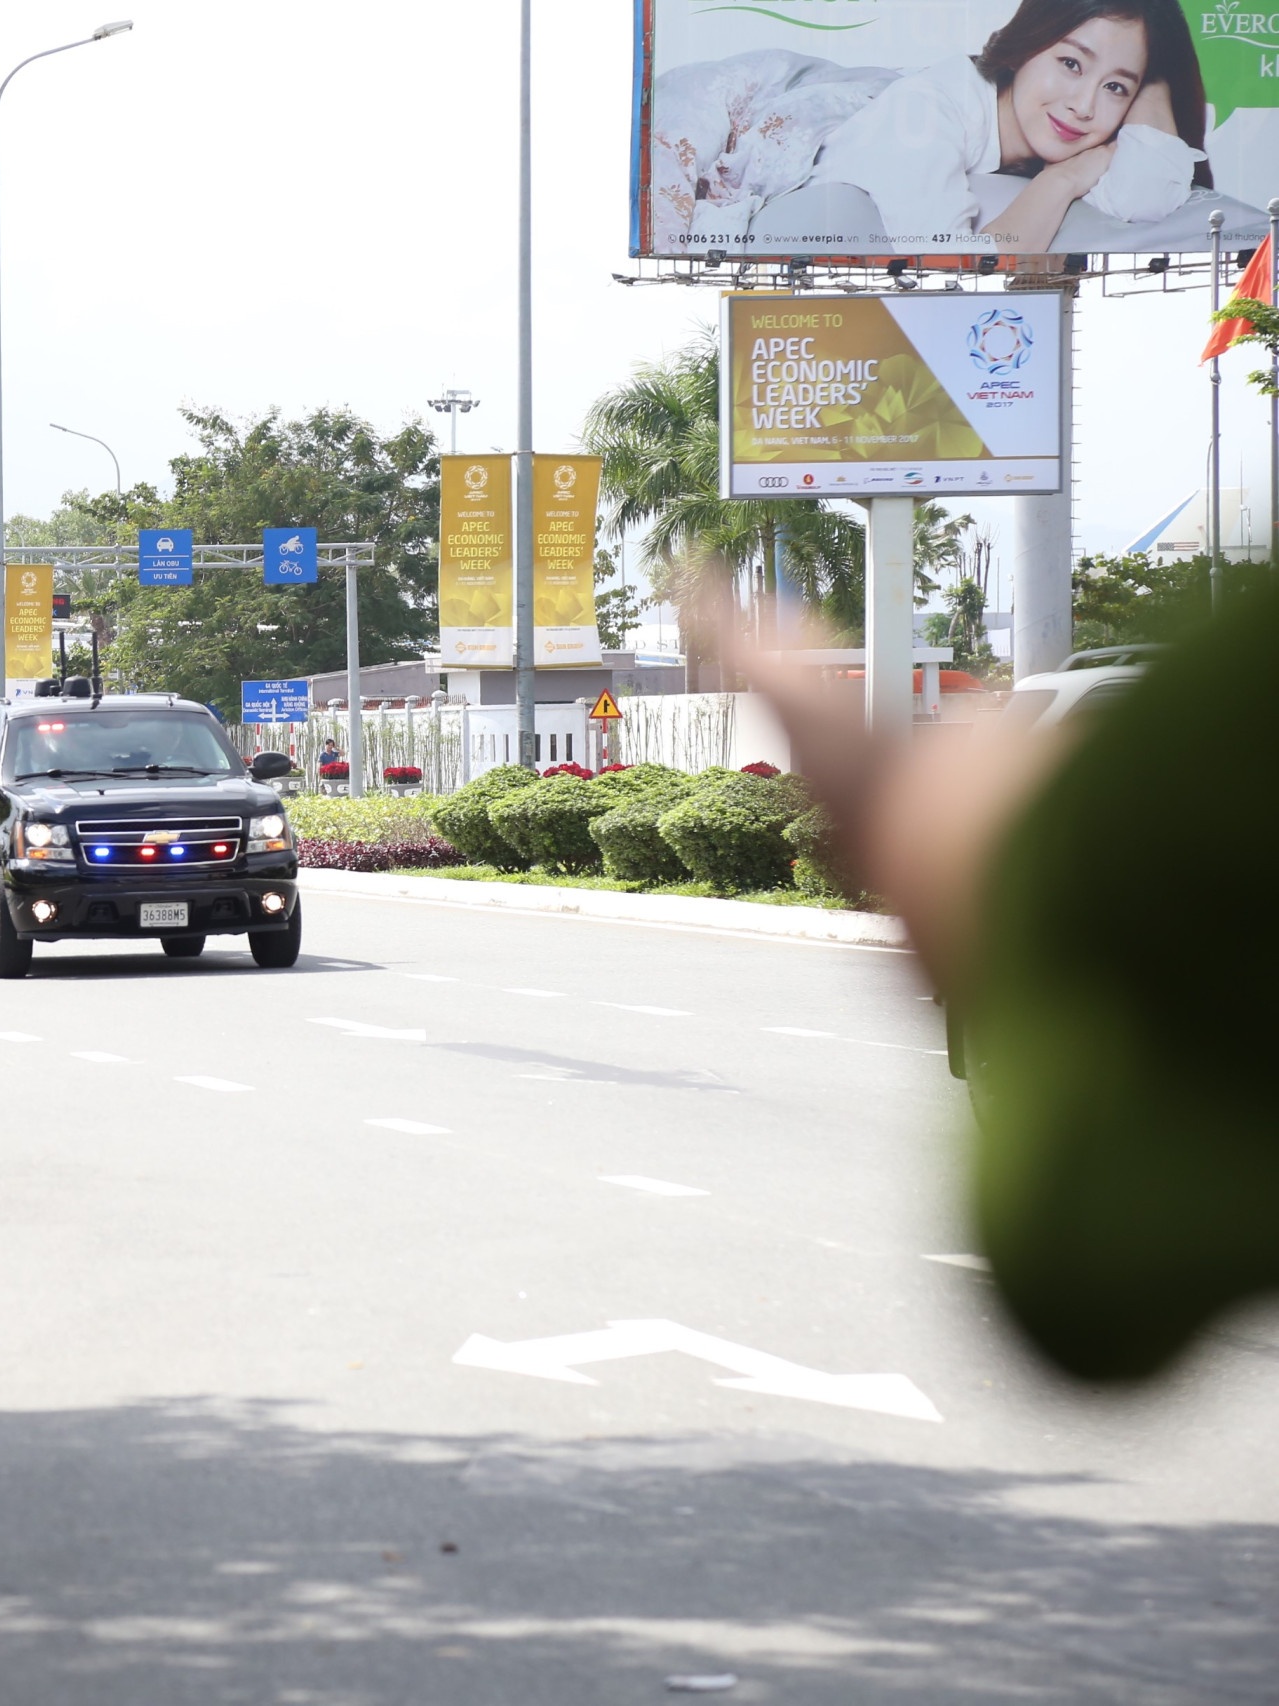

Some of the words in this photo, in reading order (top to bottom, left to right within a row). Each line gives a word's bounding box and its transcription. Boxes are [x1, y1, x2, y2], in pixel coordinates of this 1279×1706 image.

[679, 234, 707, 243] 0906
[710, 234, 730, 243] 231
[734, 234, 755, 243] 669
[774, 233, 859, 244] www.everpia.vn
[869, 233, 928, 243] Showroom:
[932, 233, 951, 243] 437
[751, 314, 820, 329] WELCOME
[823, 313, 843, 328] TO
[751, 337, 815, 360] APEC
[752, 359, 879, 384] ECONOMIC
[980, 381, 1020, 389] APEC
[752, 383, 868, 407] LEADERS'
[966, 391, 999, 400] VIET
[1000, 390, 1034, 399] NAM
[752, 406, 822, 430] WEEK
[572, 510, 580, 518] TO
[462, 521, 490, 532] APEC
[549, 521, 574, 532] APEC
[448, 534, 504, 545] ECONOMIC
[538, 533, 586, 545] ECONOMIC
[460, 559, 491, 570] WEEK
[548, 559, 574, 570] WEEK
[10, 617, 47, 625] ECONOMIC
[17, 633, 38, 641] WEEK
